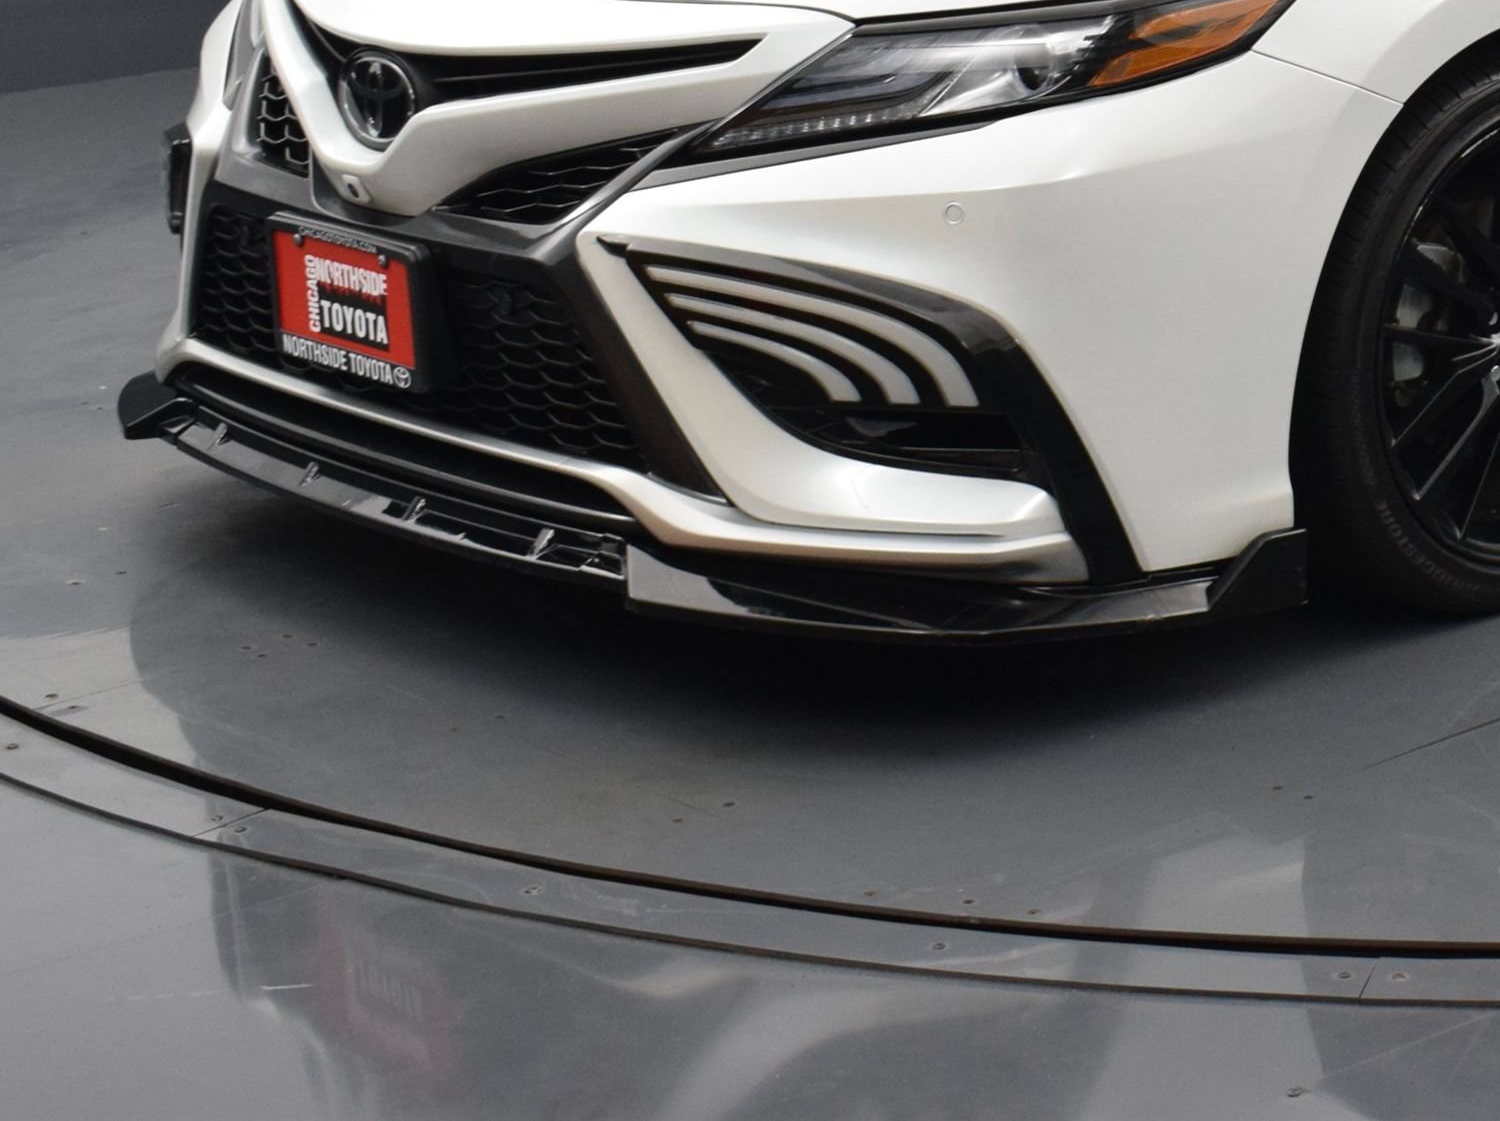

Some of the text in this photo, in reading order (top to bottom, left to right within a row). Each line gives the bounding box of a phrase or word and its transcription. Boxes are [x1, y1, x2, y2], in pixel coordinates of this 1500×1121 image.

[304, 254, 321, 333] CHICAGO
[316, 257, 388, 296] NORTHSIDE
[320, 299, 388, 345] TOYOTA
[282, 334, 393, 385] NORTHSIDE TOYOTA
